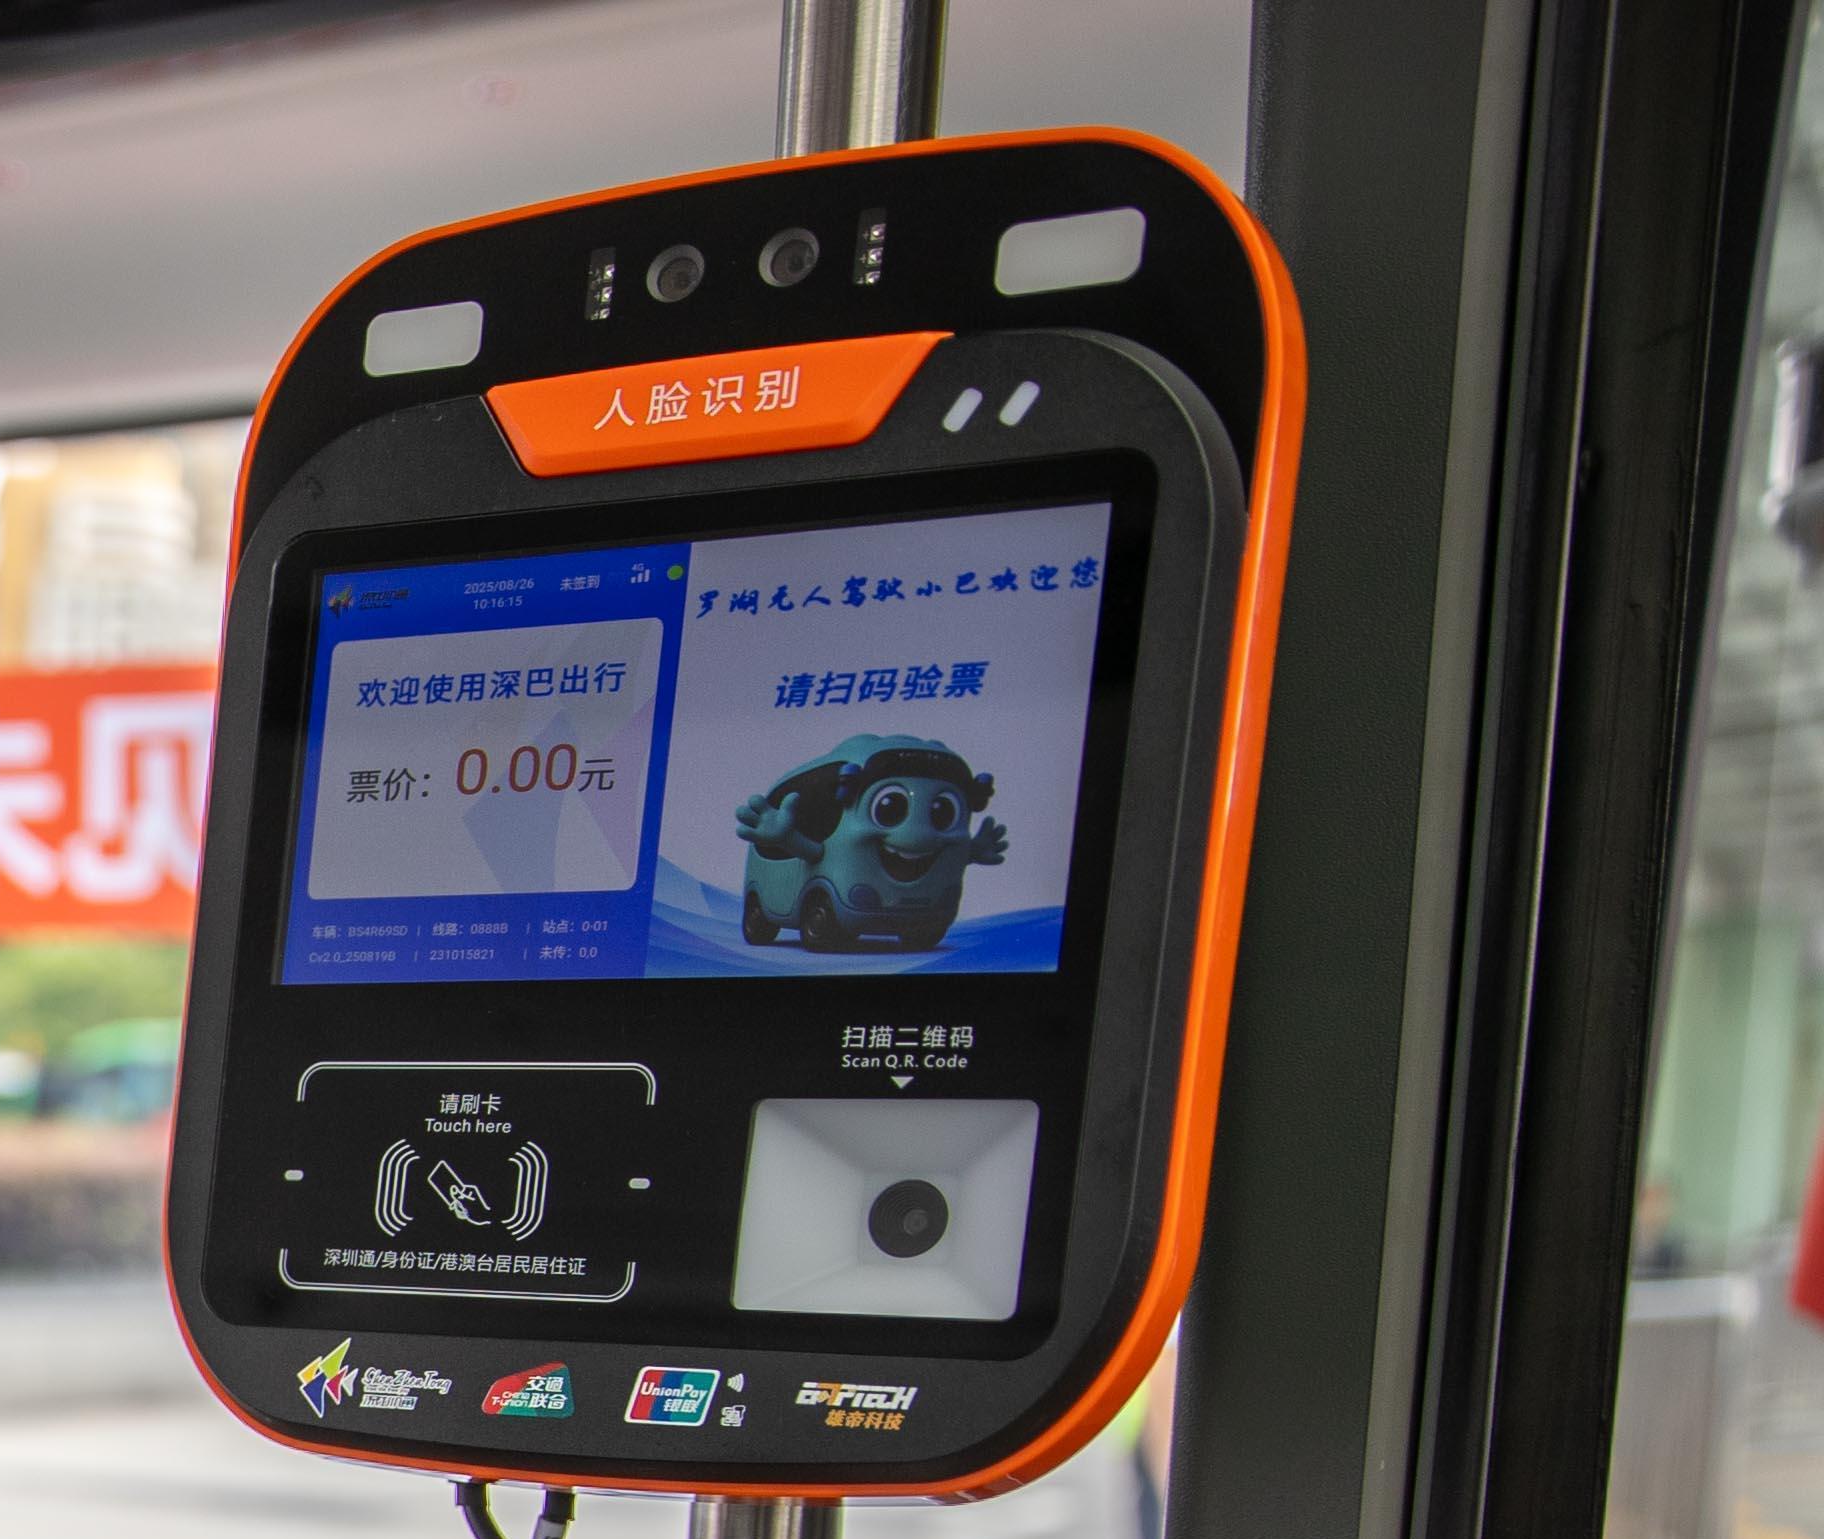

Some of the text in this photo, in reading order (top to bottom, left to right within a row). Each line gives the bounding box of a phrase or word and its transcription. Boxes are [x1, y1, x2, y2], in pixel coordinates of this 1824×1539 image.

[593, 365, 800, 431] 人脸识别
[464, 577, 535, 596] 2025/08/26
[560, 575, 600, 592] 未签到
[695, 556, 1100, 619] 罗湖无人驾驶小巴欢迎您
[472, 595, 523, 611] 10:16:15
[356, 662, 627, 708] 欢迎使用深巴出行
[774, 661, 989, 709] 请扫码验票
[841, 1025, 974, 1049] 扫描二维码
[841, 1054, 968, 1069] Scan Q.R. Code
[439, 1093, 502, 1115] 请刷卡
[424, 1118, 512, 1134] Touch here
[323, 1248, 587, 1276] 深圳通/身份证/港澳台居民居住证
[525, 1376, 565, 1393] 交通
[640, 1381, 709, 1399] UnionPay
[528, 1393, 568, 1410] 联合
[663, 1399, 698, 1413] 银联
